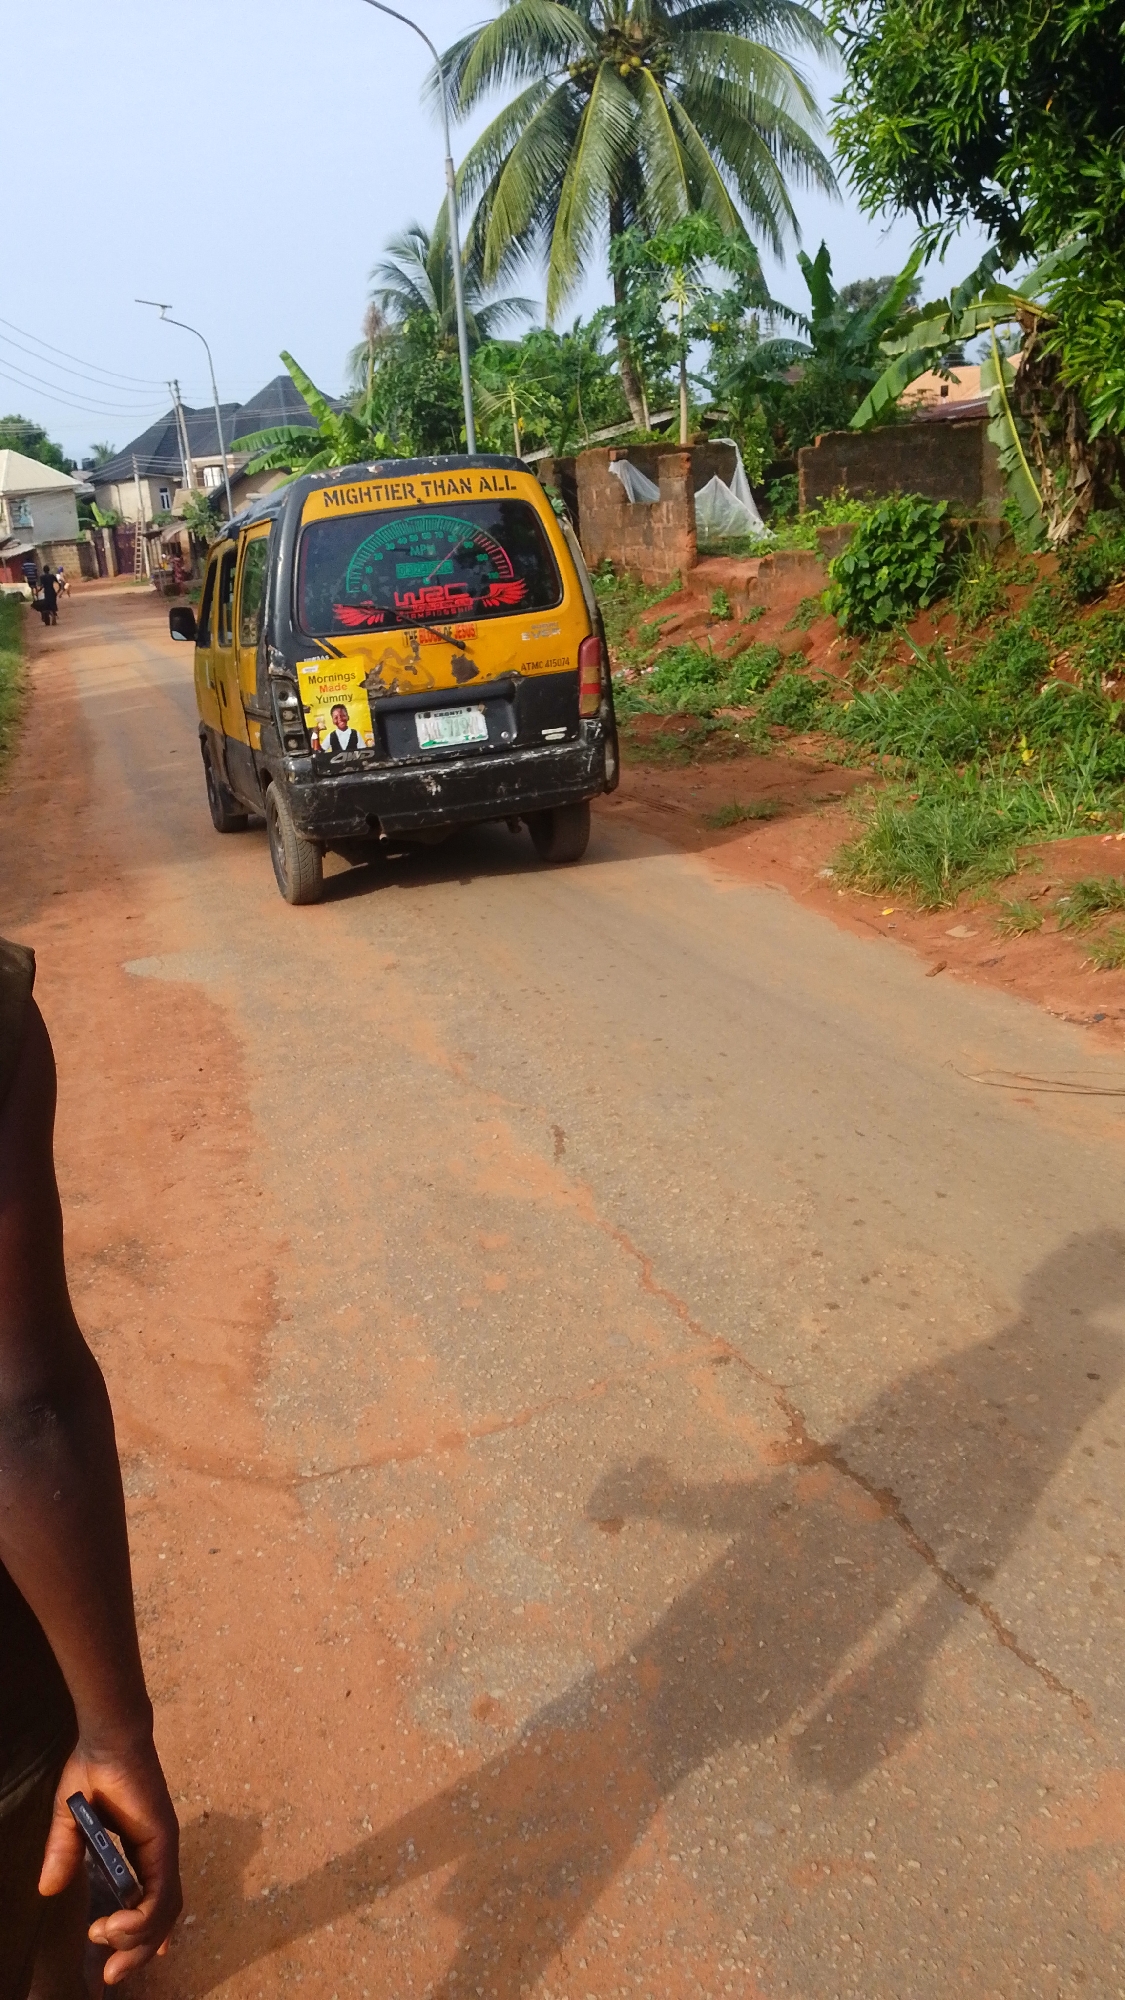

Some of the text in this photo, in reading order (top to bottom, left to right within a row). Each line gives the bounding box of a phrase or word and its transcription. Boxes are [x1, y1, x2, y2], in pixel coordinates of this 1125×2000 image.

[323, 475, 517, 508] MIGHTIER THAN ALL
[454, 624, 476, 640] JESUS
[521, 661, 544, 671] ATMC
[308, 672, 356, 685] Mornings
[319, 683, 348, 694] Made
[315, 693, 354, 705] Yummy
[330, 750, 375, 764] 4WD
